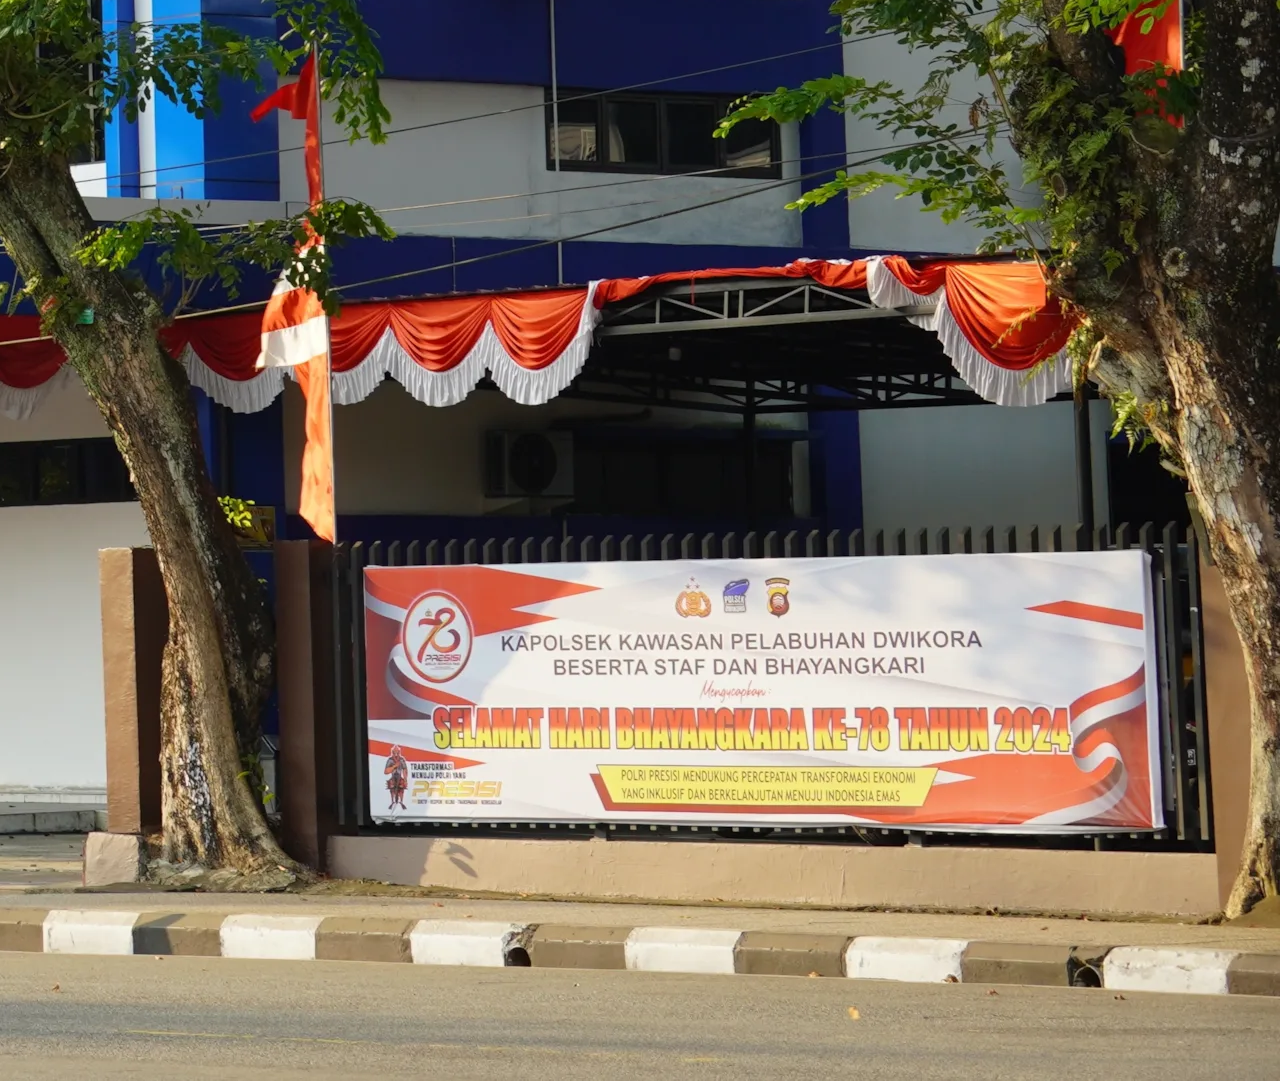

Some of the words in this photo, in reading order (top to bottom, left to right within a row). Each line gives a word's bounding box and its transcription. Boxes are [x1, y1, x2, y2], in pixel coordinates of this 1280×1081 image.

[501, 634, 612, 651] KAPOLSEK
[619, 633, 723, 651] KAWASAN
[731, 632, 865, 650] PELABUHAN
[874, 631, 982, 648] DWIKORA
[554, 659, 648, 675] BESERTA
[654, 659, 705, 675] STAF
[713, 658, 757, 675] DAN
[765, 657, 924, 674] BHAYANGKARI
[433, 706, 544, 750] SELAMAT
[549, 707, 610, 749] HARI
[615, 707, 809, 751] BHAYANGKARA
[812, 706, 890, 752] KE-78
[894, 707, 989, 752] TAHUN
[995, 706, 1071, 752] 2024
[410, 763, 453, 771] TRANSFORMASI
[621, 769, 646, 781] POLRI
[649, 769, 680, 782] PRESISI
[683, 770, 739, 783] MENDUKUNG
[741, 771, 797, 783] PERCEPATAN
[801, 771, 870, 784] TRANSFORMASI
[873, 772, 916, 784] EKONOMI
[412, 781, 502, 797] PRESISI
[621, 788, 645, 799] YANG
[646, 788, 685, 800] INKLUSIF
[687, 788, 706, 800] DAN
[708, 789, 783, 801] BERKELANJUTAN
[785, 789, 823, 802] MENUJU
[825, 790, 874, 802] INDONESIA
[876, 790, 901, 802] EMAS
